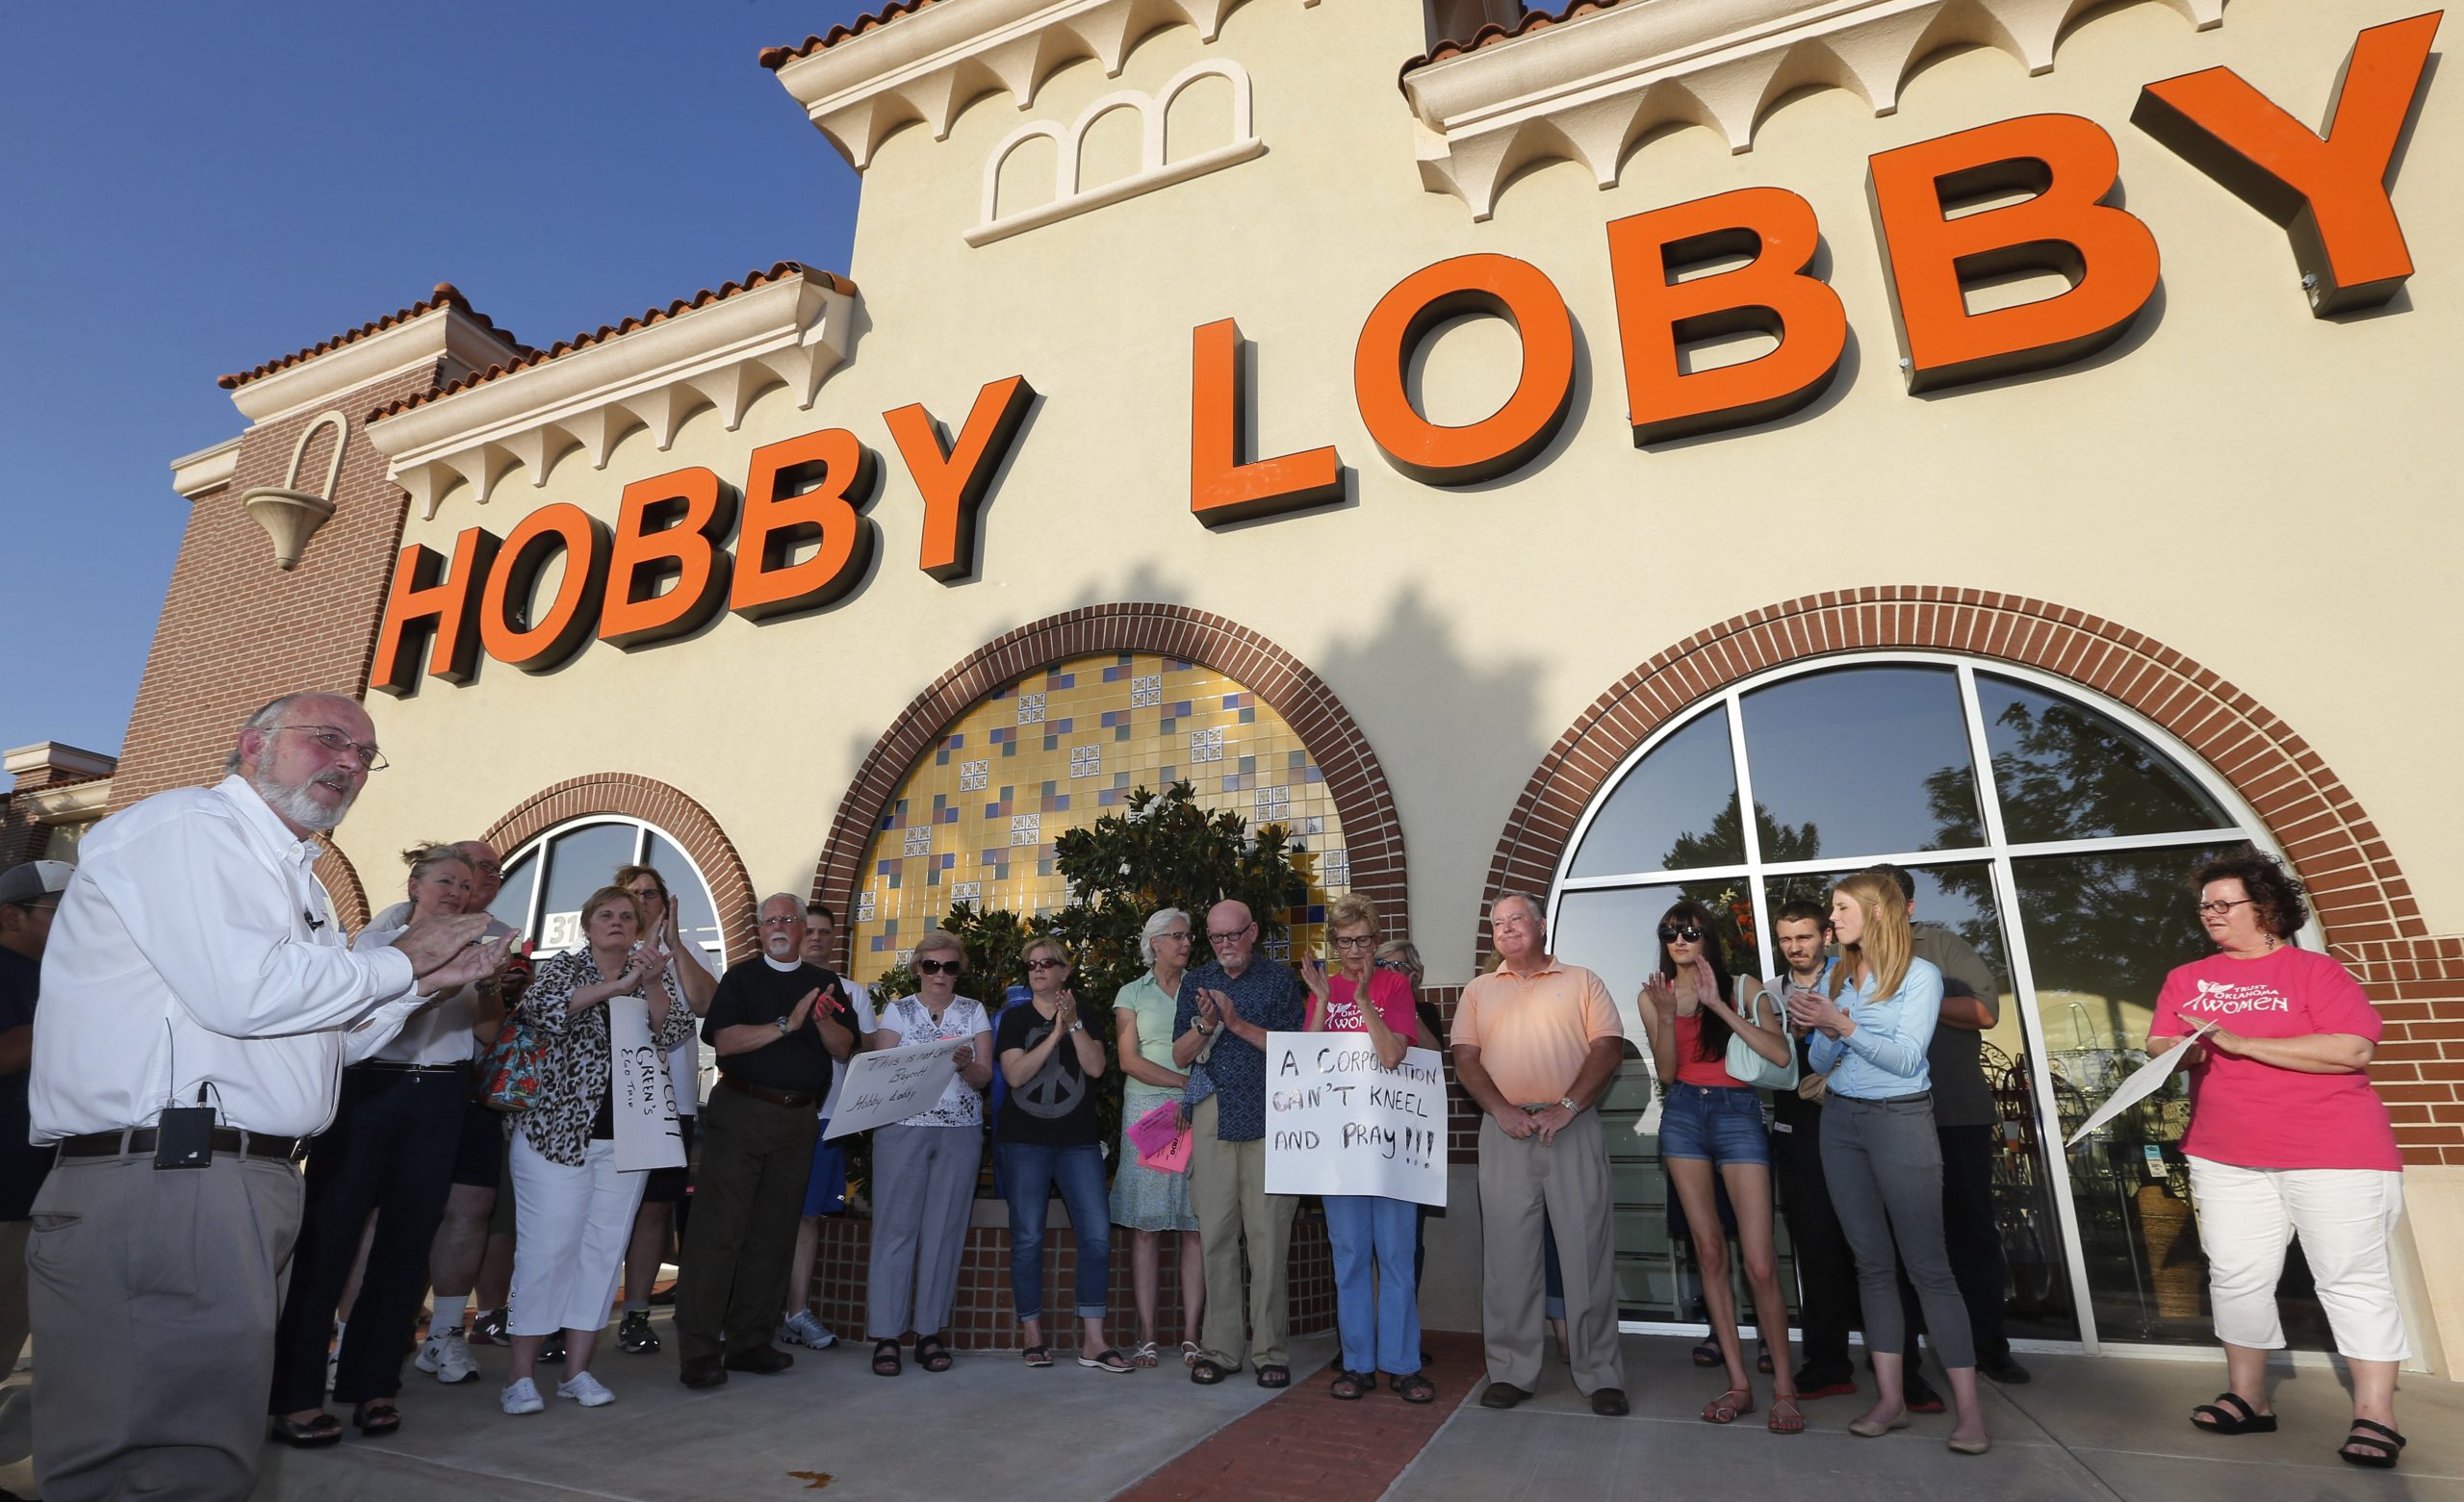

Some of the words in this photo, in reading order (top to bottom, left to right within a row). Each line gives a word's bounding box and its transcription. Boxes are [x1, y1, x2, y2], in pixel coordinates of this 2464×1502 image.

[370, 374, 1037, 699] HOBBY
[1191, 10, 2444, 529] LOBBY
[2214, 989, 2279, 1000] OKLAHOMA
[2233, 984, 2268, 993] TRUST
[2202, 996, 2289, 1014] WOMEN
[867, 1056, 900, 1071] This
[1280, 1049, 1299, 1077] A
[635, 1046, 655, 1116] GREEN'S
[846, 1092, 885, 1114] Hobby
[1271, 1082, 1356, 1112] CAN'T
[1370, 1084, 1428, 1118] KNEEL
[1274, 1130, 1321, 1152] AND
